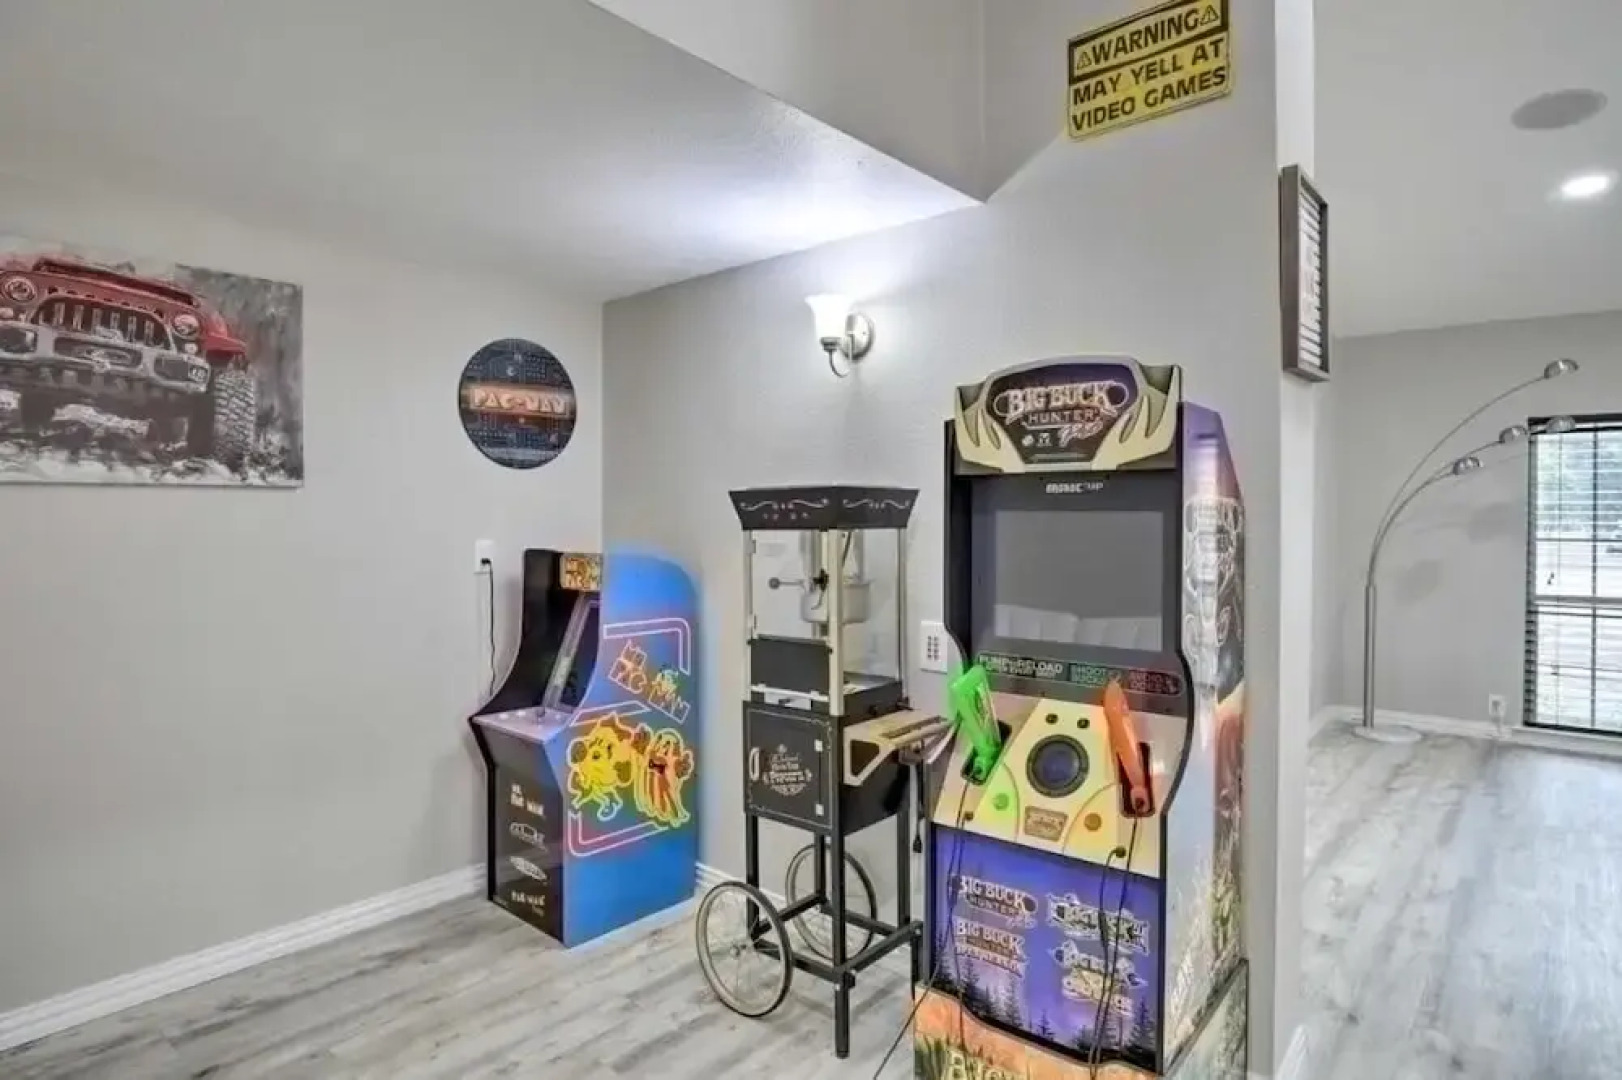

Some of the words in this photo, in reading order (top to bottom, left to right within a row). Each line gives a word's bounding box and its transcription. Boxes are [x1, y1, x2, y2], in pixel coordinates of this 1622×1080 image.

[1092, 7, 1200, 65] WARNING
[1073, 73, 1121, 105] MAY
[1131, 54, 1184, 85] YELL
[1192, 38, 1224, 66] AT
[1072, 96, 1135, 131] VIDEO
[1144, 66, 1225, 107] GAMES
[1006, 387, 1047, 416] BIG
[1048, 381, 1114, 412] BUCK
[1027, 408, 1096, 424] HUNTER
[985, 882, 1026, 912] BUCK
